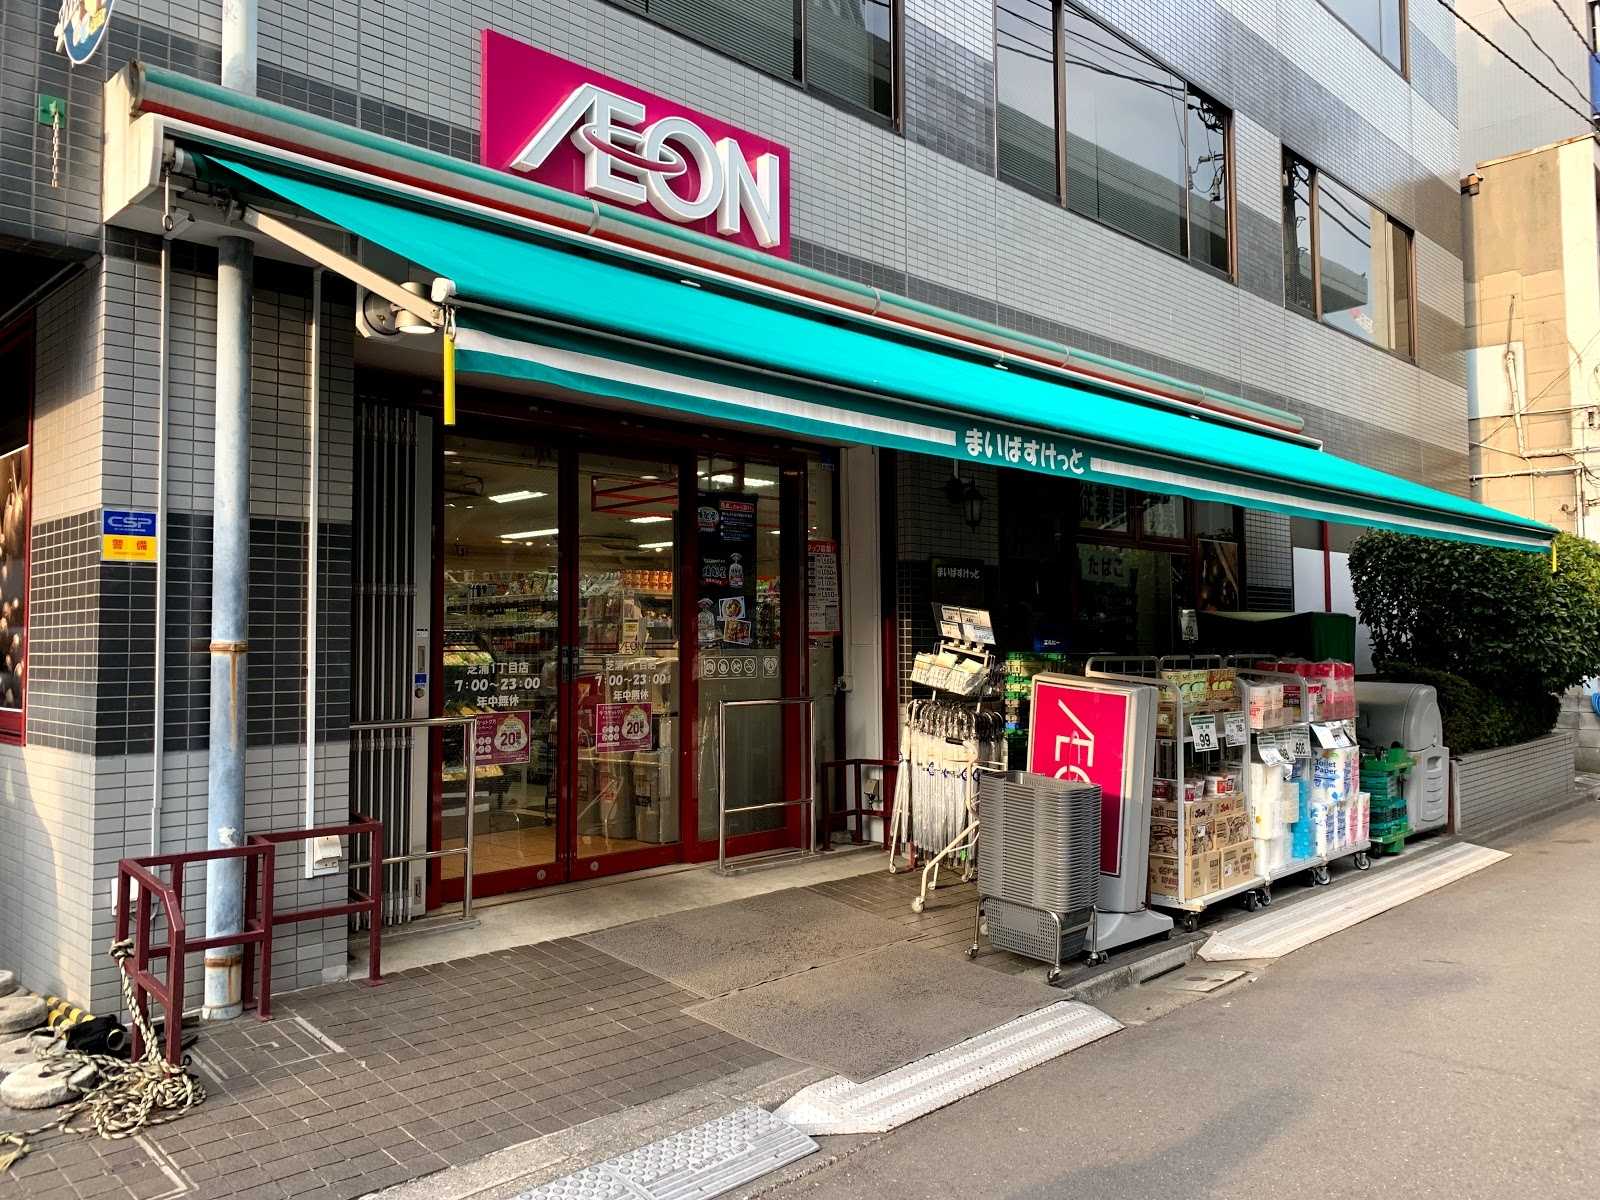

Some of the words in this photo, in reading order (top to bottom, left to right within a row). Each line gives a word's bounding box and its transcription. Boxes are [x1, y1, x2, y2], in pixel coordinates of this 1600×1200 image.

[964, 428, 1085, 475] まいばすけっと
[107, 516, 152, 528] CSP
[1087, 557, 1125, 579] たばこ
[613, 690, 649, 701] 年中無休
[476, 696, 520, 708] 年中無休
[1199, 733, 1211, 747] 99
[1314, 758, 1336, 768] Toilet
[1314, 766, 1336, 775] Paper
